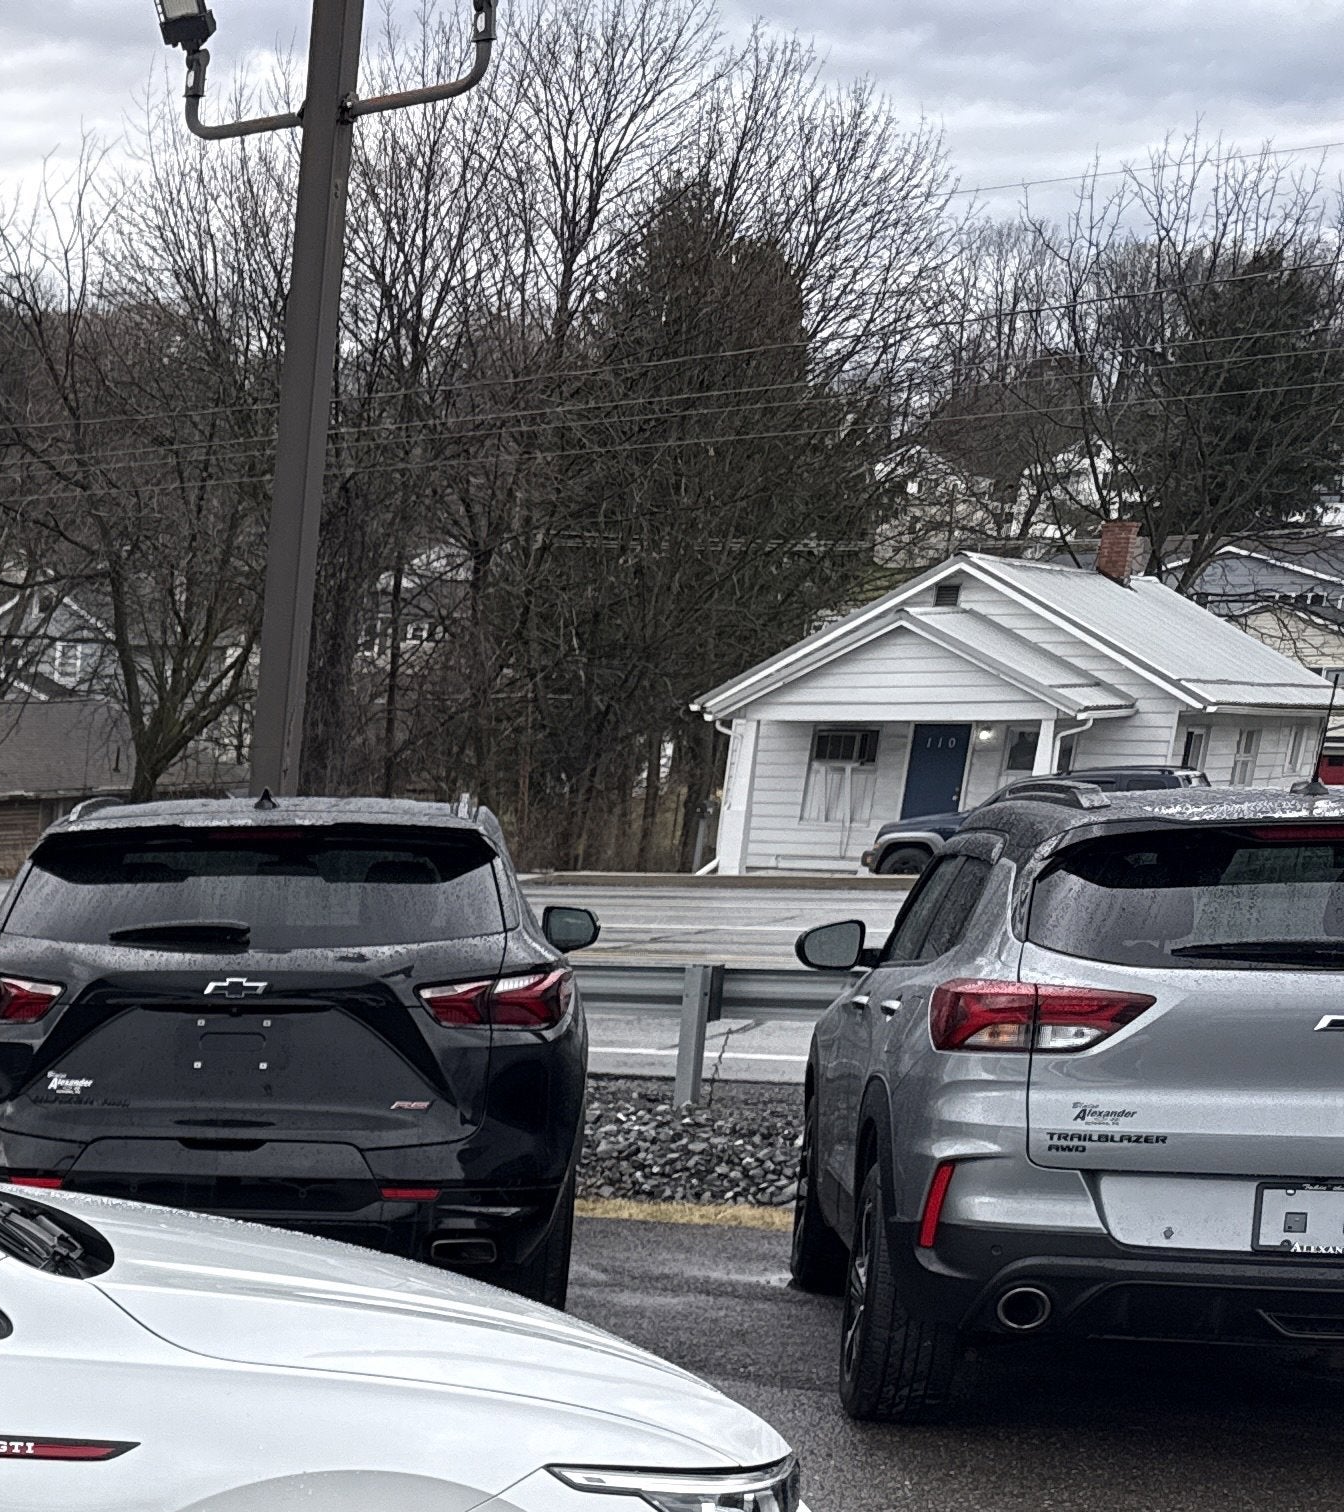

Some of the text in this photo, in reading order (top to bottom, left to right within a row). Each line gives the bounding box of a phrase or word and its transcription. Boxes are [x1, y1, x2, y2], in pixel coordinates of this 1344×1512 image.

[926, 737, 956, 748] 110
[48, 1077, 93, 1090] Alexander
[390, 1101, 430, 1110] RS
[1073, 1108, 1138, 1122] Alexander
[1046, 1131, 1168, 1145] TRAILBLAZER
[1047, 1144, 1087, 1153] AWD
[1290, 1241, 1344, 1255] ALEXAN
